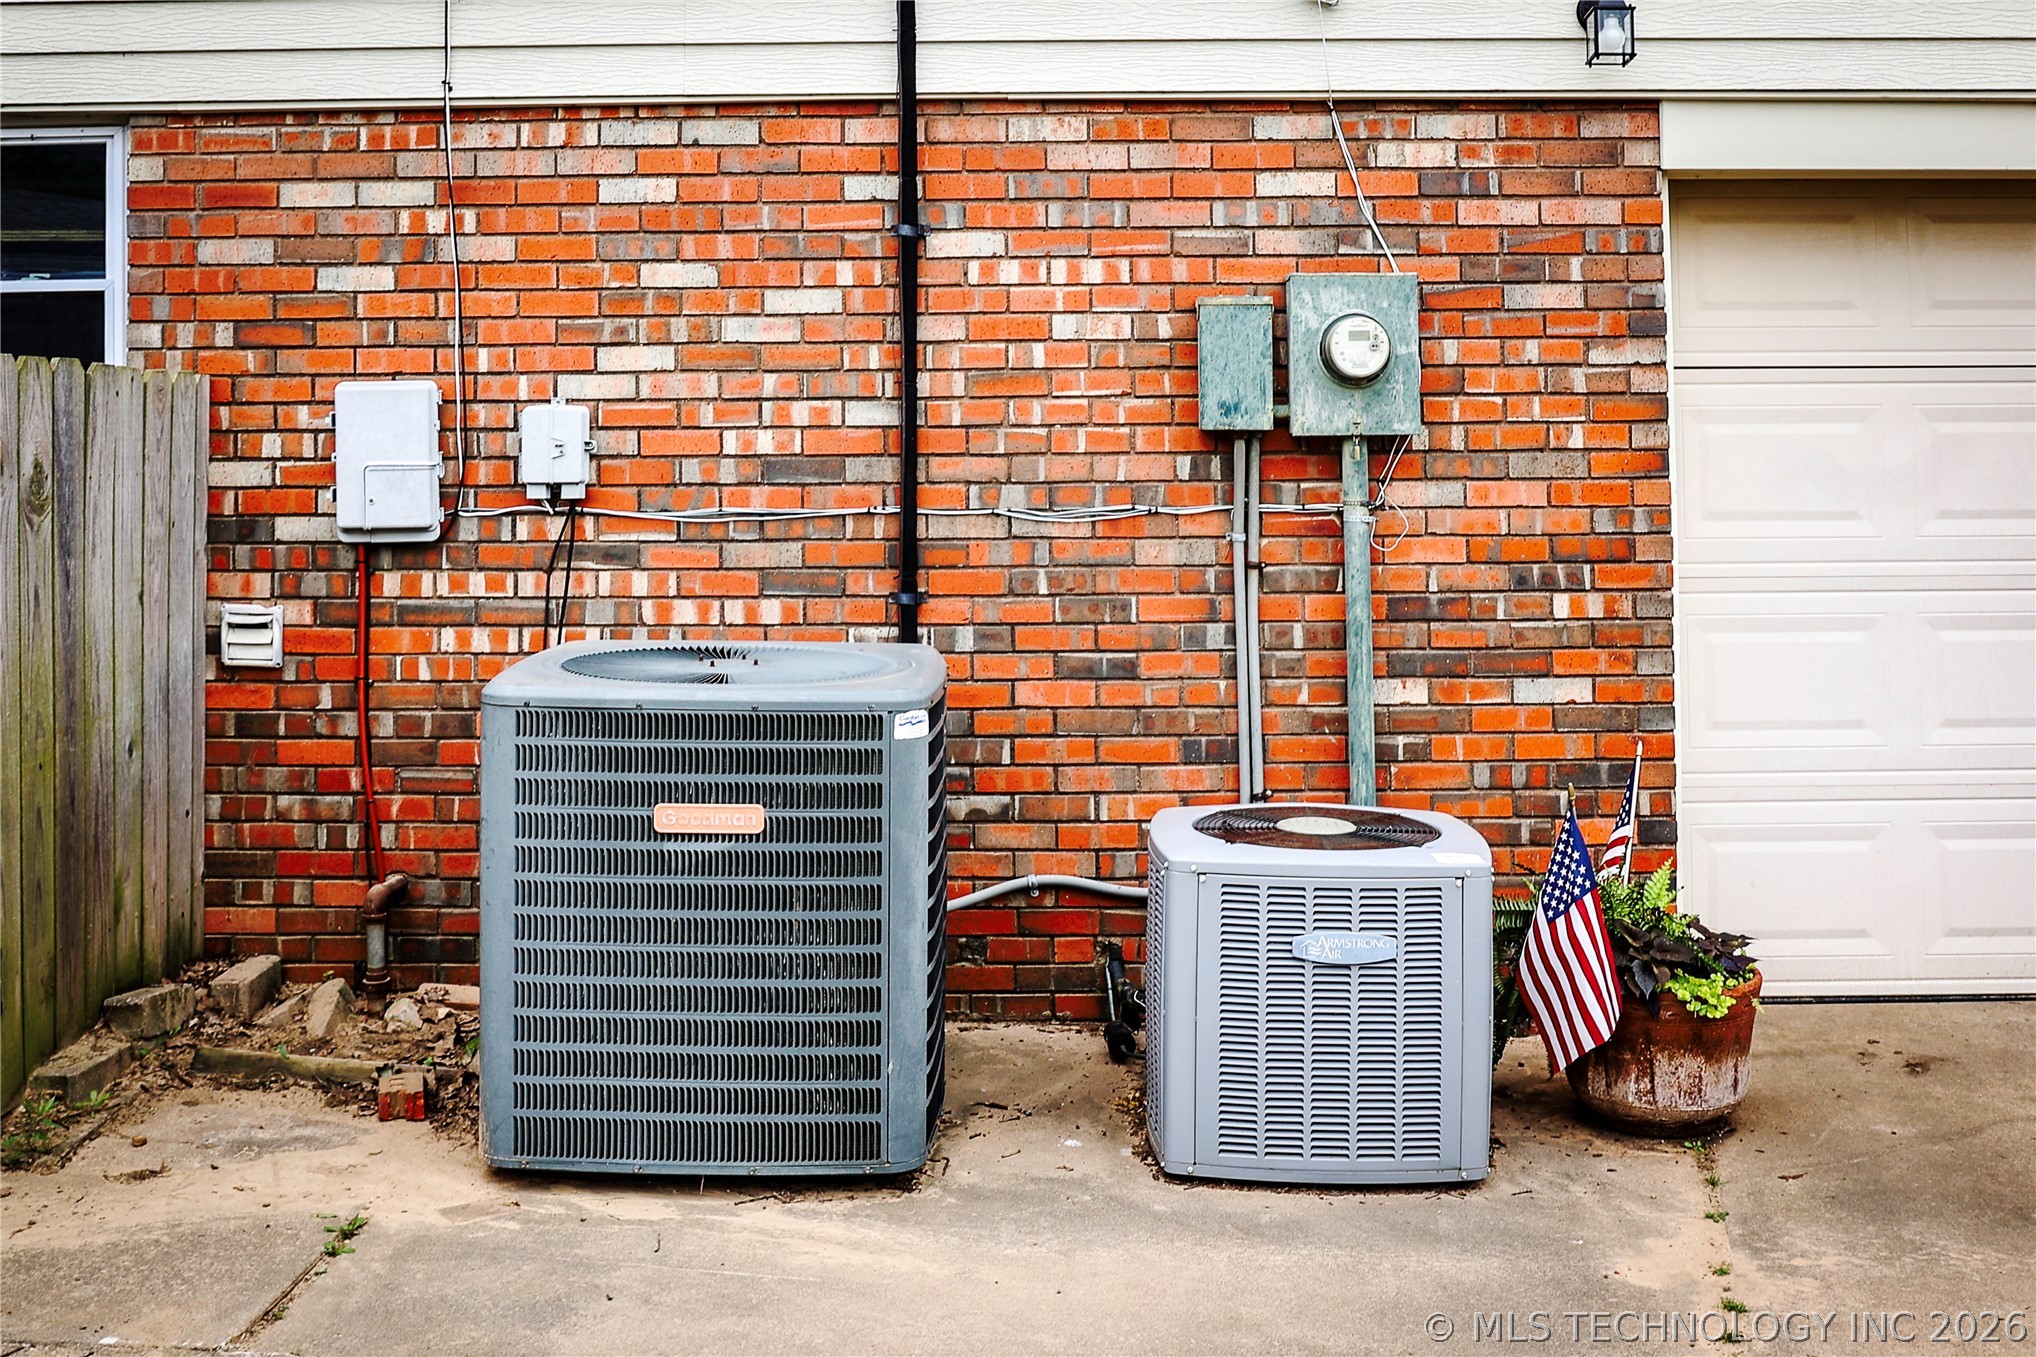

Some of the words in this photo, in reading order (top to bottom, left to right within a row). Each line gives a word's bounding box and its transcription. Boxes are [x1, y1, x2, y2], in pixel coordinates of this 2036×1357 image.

[661, 809, 757, 827] Goodman
[1316, 935, 1390, 949] ARMSTRONG
[1321, 946, 1342, 960] AIR
